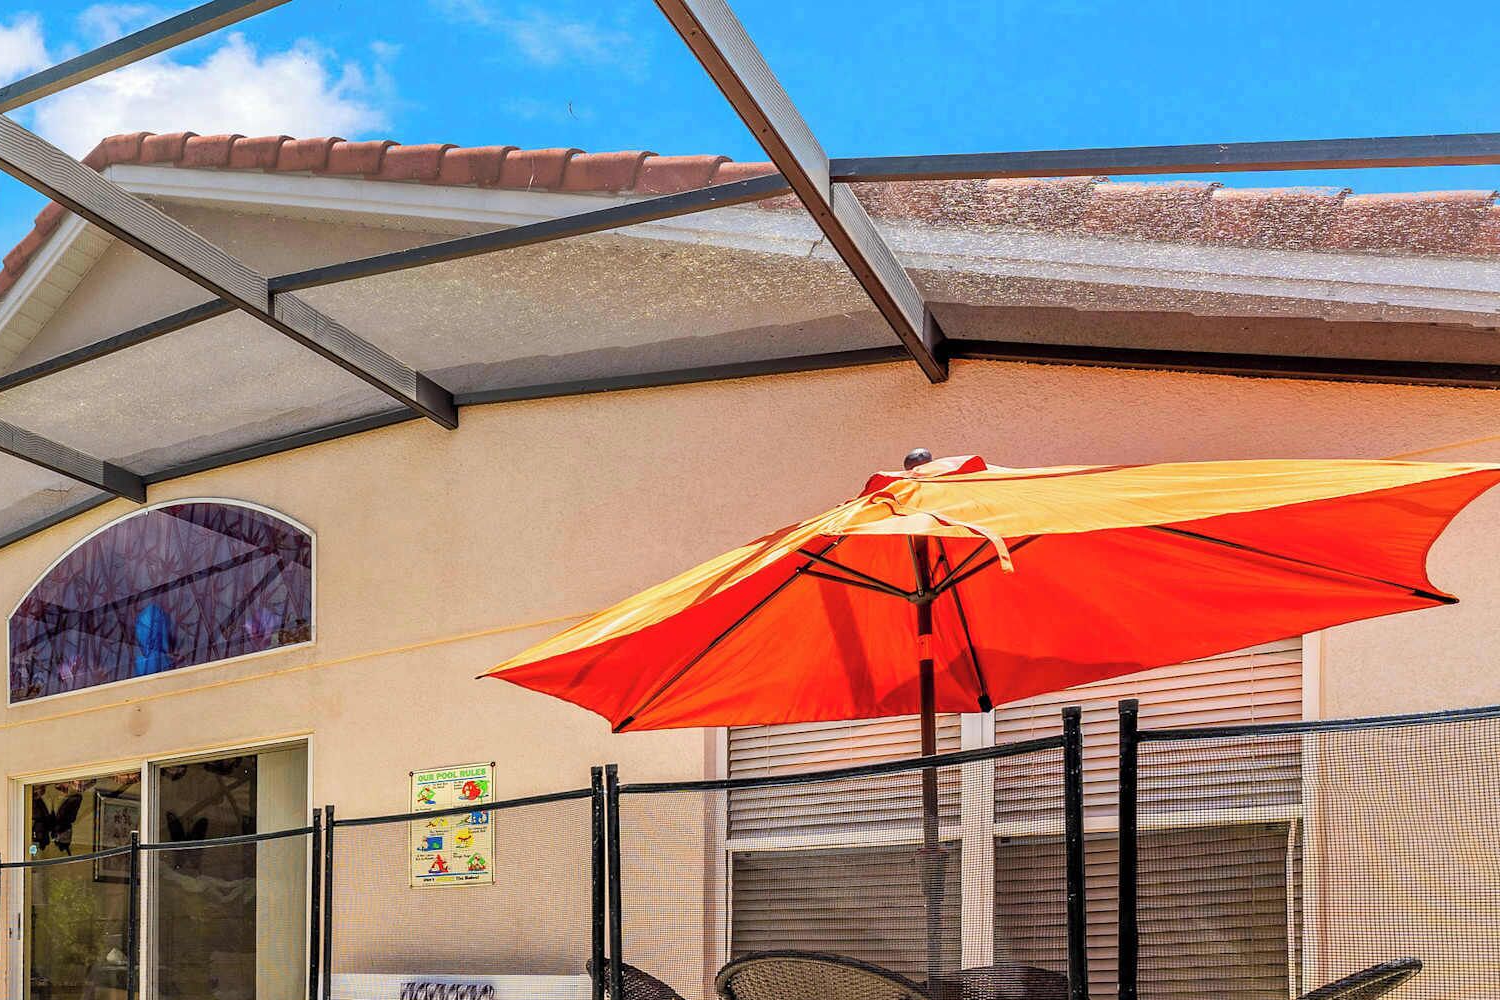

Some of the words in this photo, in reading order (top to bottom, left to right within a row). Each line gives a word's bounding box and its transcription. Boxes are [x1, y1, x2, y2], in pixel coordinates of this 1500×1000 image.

[418, 774, 434, 782] OUR
[436, 771, 457, 780] POOL
[460, 768, 486, 778] RULES
